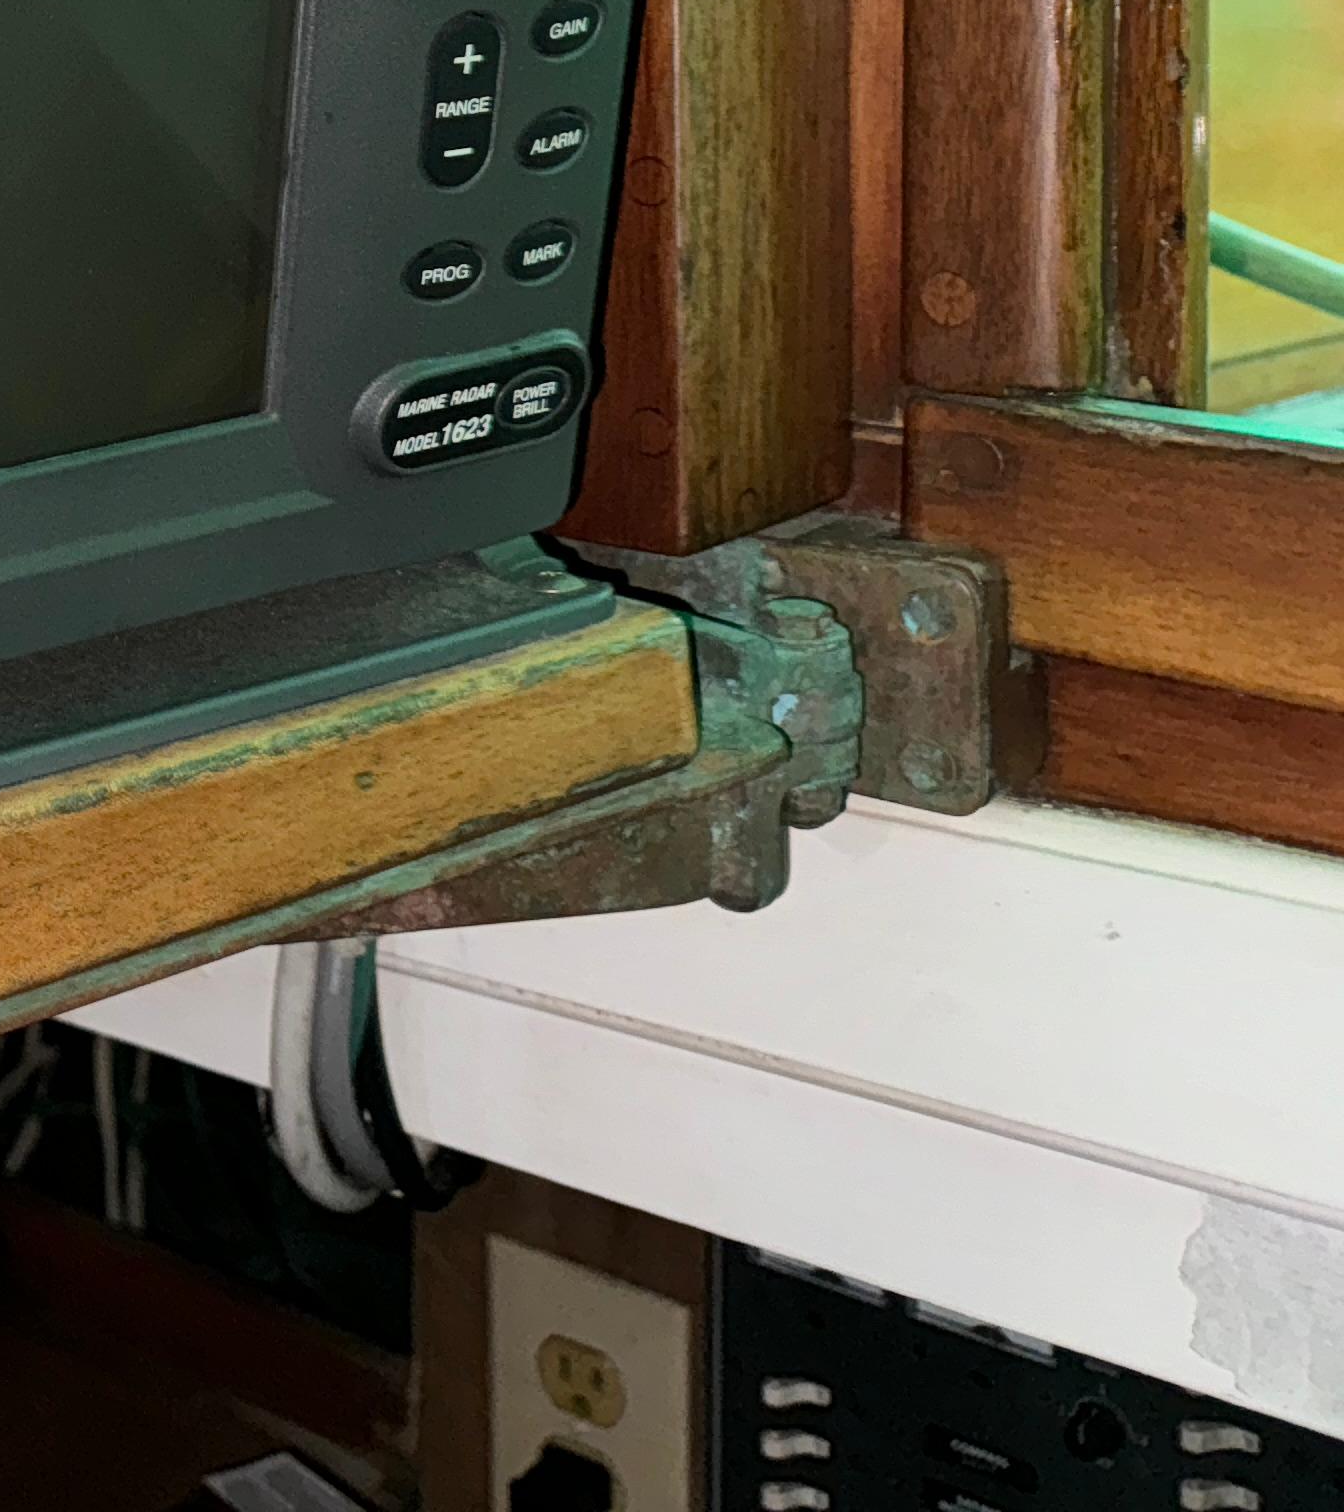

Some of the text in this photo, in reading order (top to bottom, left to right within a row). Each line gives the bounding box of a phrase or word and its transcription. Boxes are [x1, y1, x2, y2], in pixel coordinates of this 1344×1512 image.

[549, 16, 589, 40] GAIN
[435, 96, 493, 119] RANGE
[530, 129, 580, 156] ALARM
[522, 241, 563, 266] MARK
[421, 263, 473, 286] PROG
[397, 382, 497, 419] MARINE RADAR
[513, 381, 556, 403] POWER
[513, 400, 552, 419] BRILL
[393, 414, 493, 457] MODEL 1623
